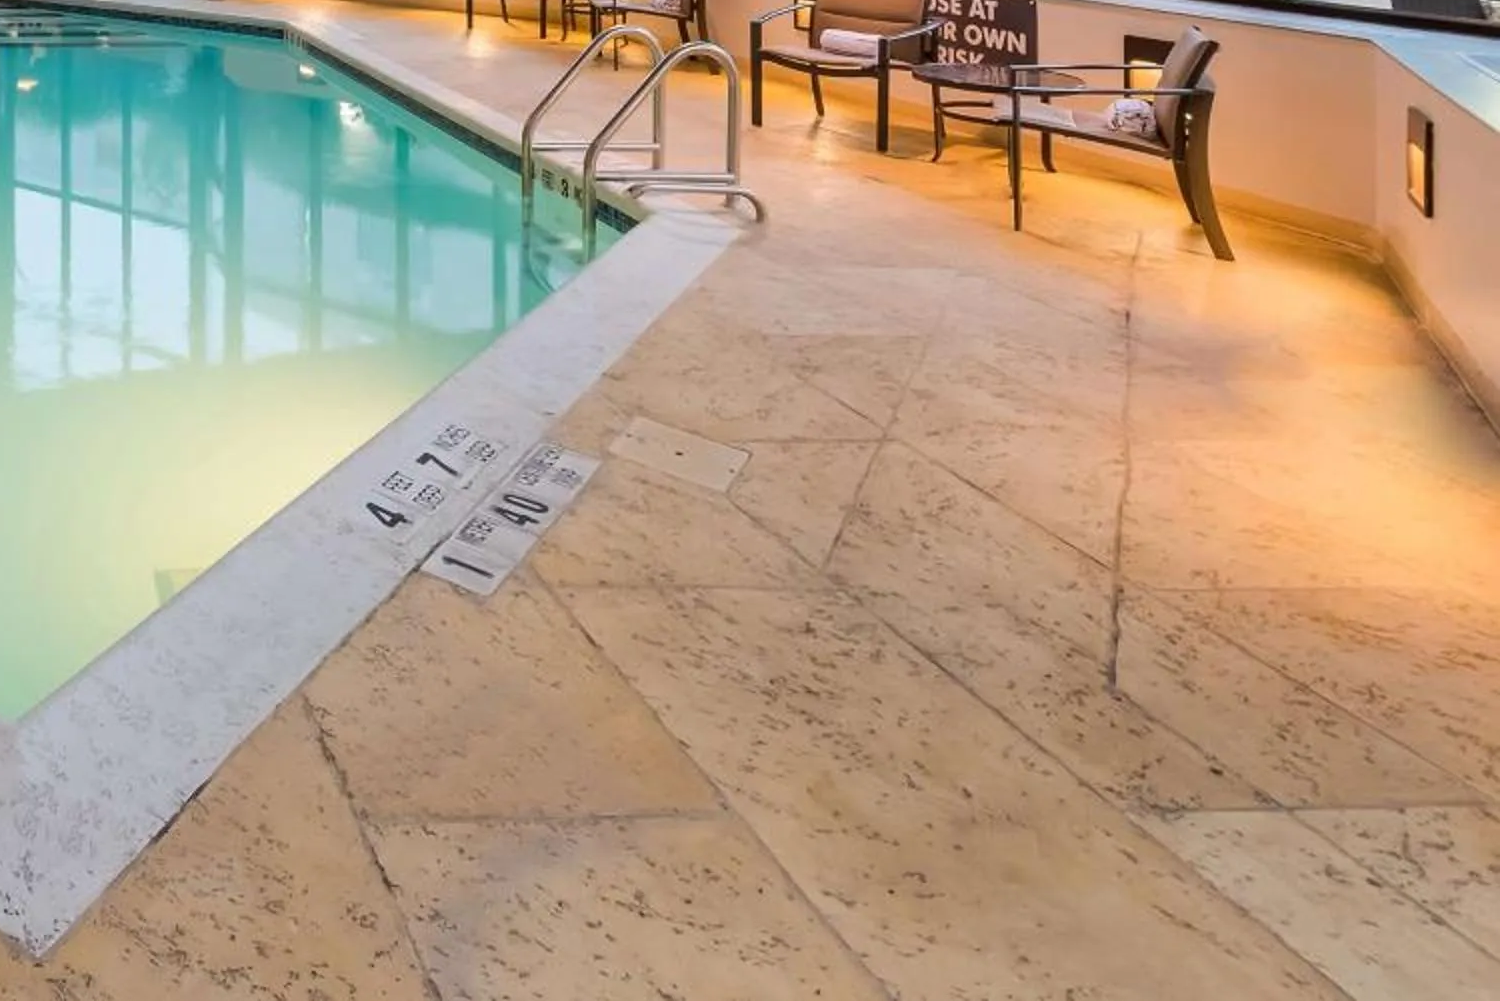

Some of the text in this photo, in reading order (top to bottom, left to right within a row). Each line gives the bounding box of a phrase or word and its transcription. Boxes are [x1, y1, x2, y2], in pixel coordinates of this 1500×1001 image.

[963, 24, 1027, 55] OWN
[365, 502, 413, 528] 4
[414, 452, 459, 477] 7
[441, 555, 495, 579] 1
[493, 494, 550, 527] 40
